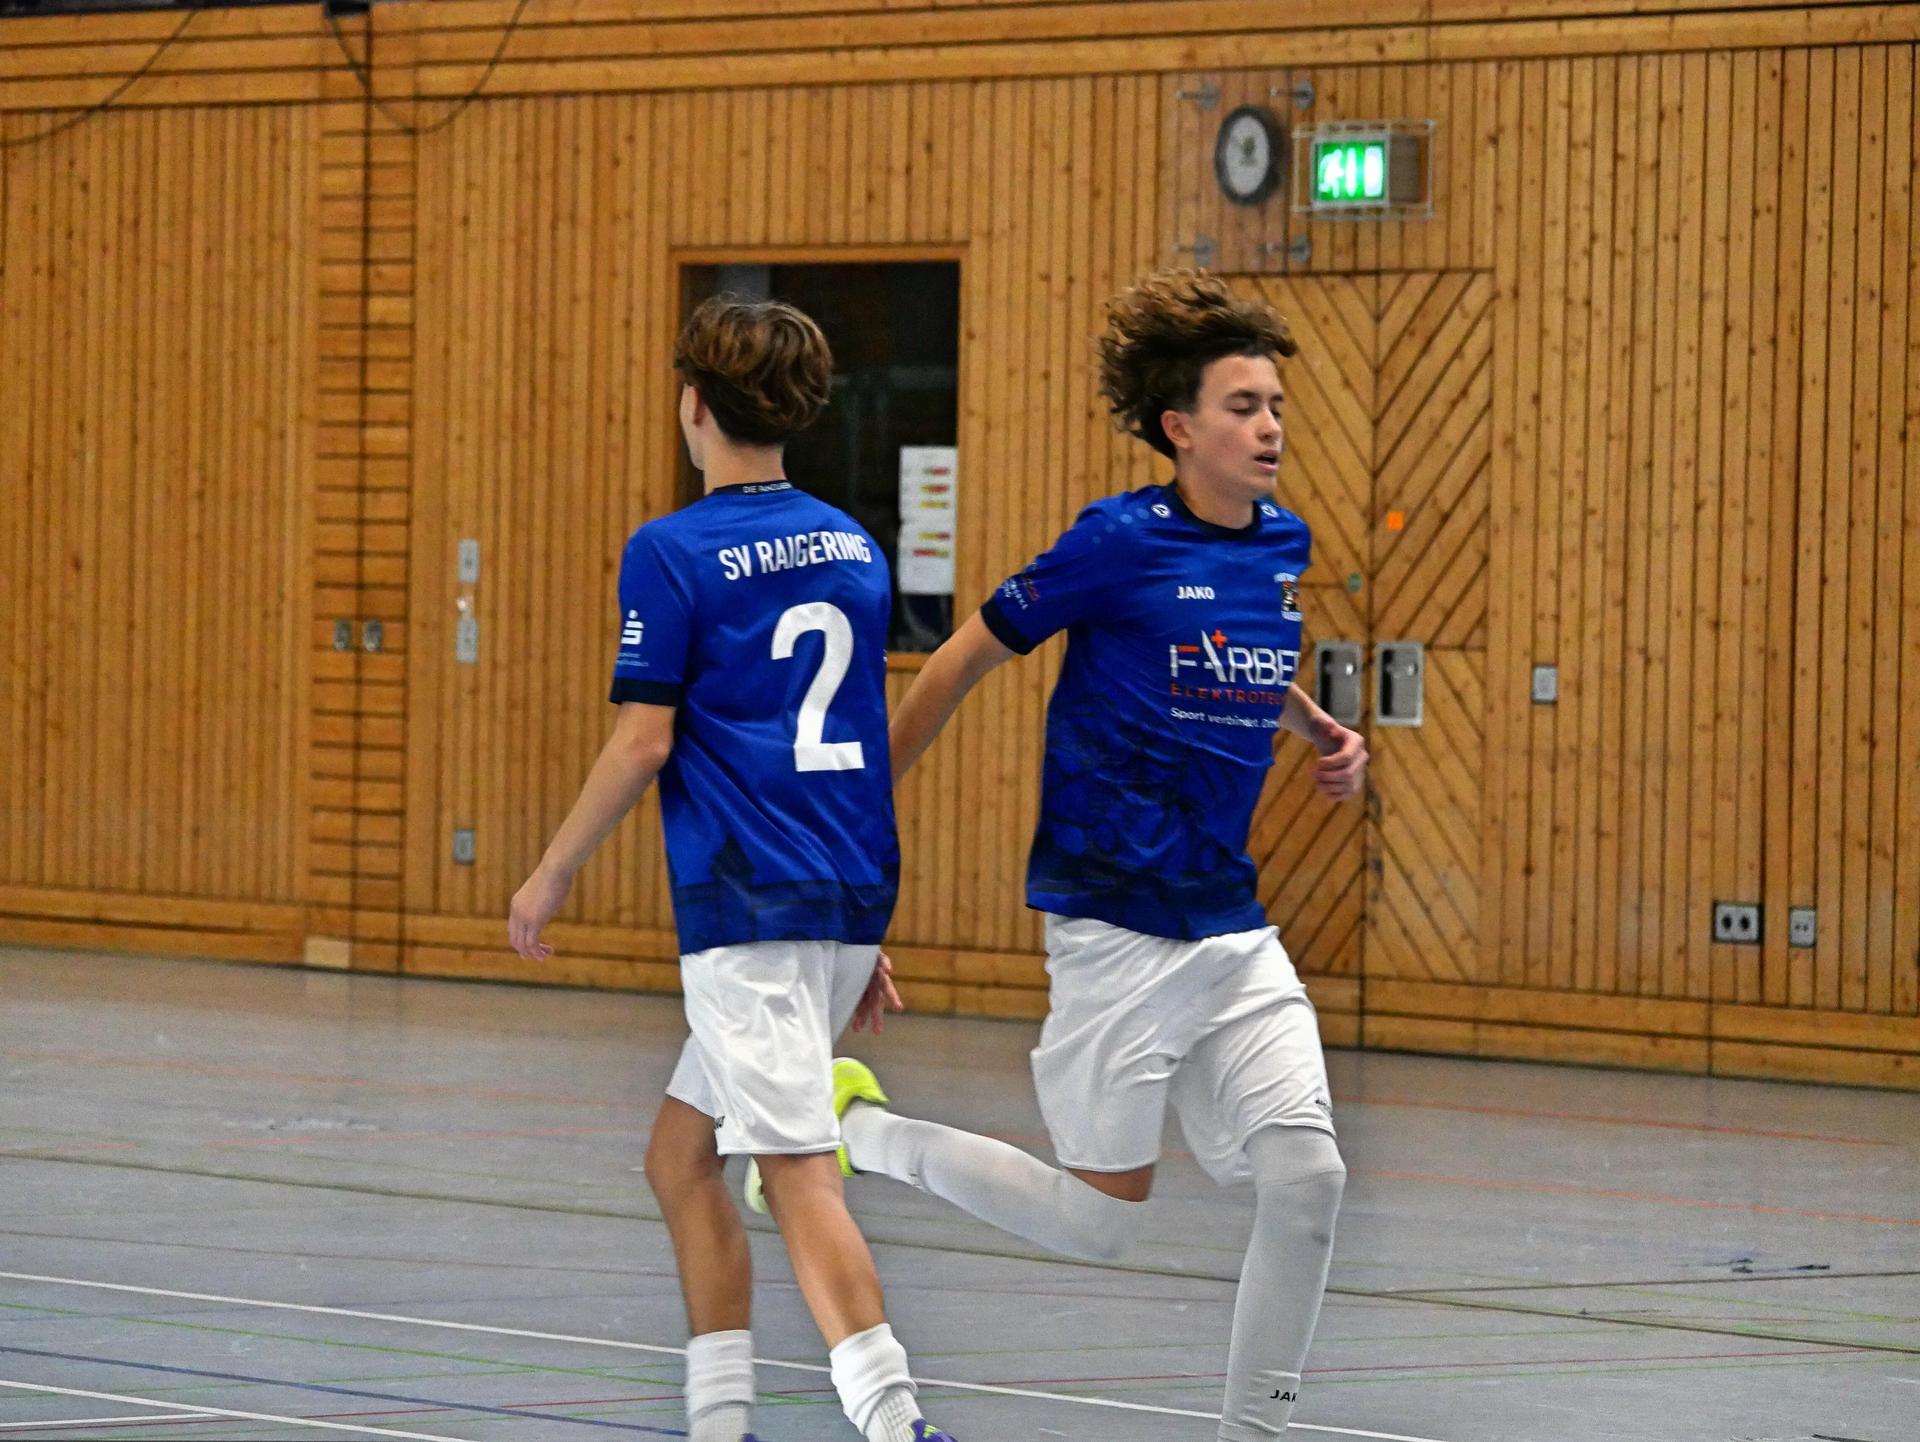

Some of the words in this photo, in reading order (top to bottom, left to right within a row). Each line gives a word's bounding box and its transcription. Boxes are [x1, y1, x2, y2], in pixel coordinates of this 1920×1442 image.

[718, 545, 752, 581] SV
[754, 531, 872, 574] RAIGERING
[1176, 586, 1215, 600] JAKO
[771, 601, 865, 772] 2
[1170, 707, 1205, 721] Sport
